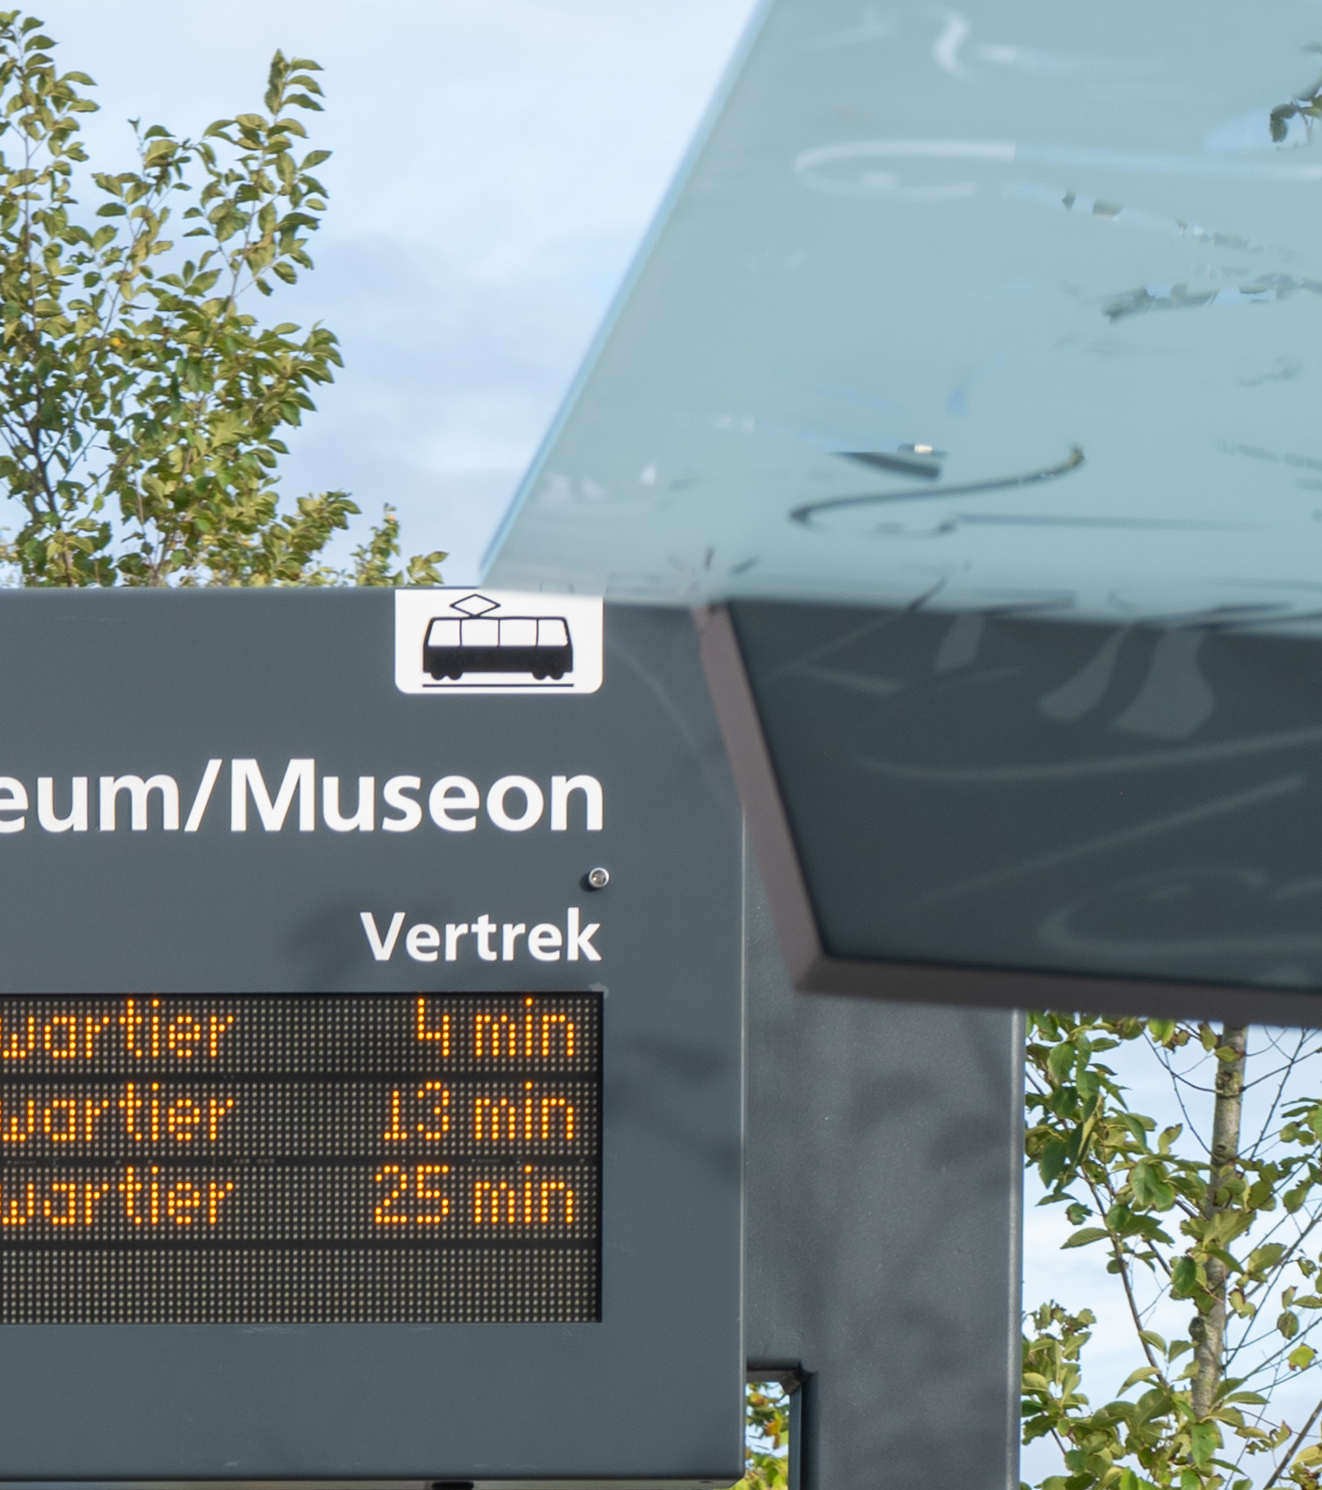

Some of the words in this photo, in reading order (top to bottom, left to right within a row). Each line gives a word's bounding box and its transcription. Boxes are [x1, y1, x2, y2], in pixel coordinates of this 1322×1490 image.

[359, 907, 603, 963] Vertrek
[416, 999, 450, 1058] 4
[473, 998, 575, 1058] min
[382, 1081, 450, 1142] 13
[473, 1080, 575, 1142] min
[373, 1164, 450, 1226] 25
[473, 1163, 575, 1225] min
